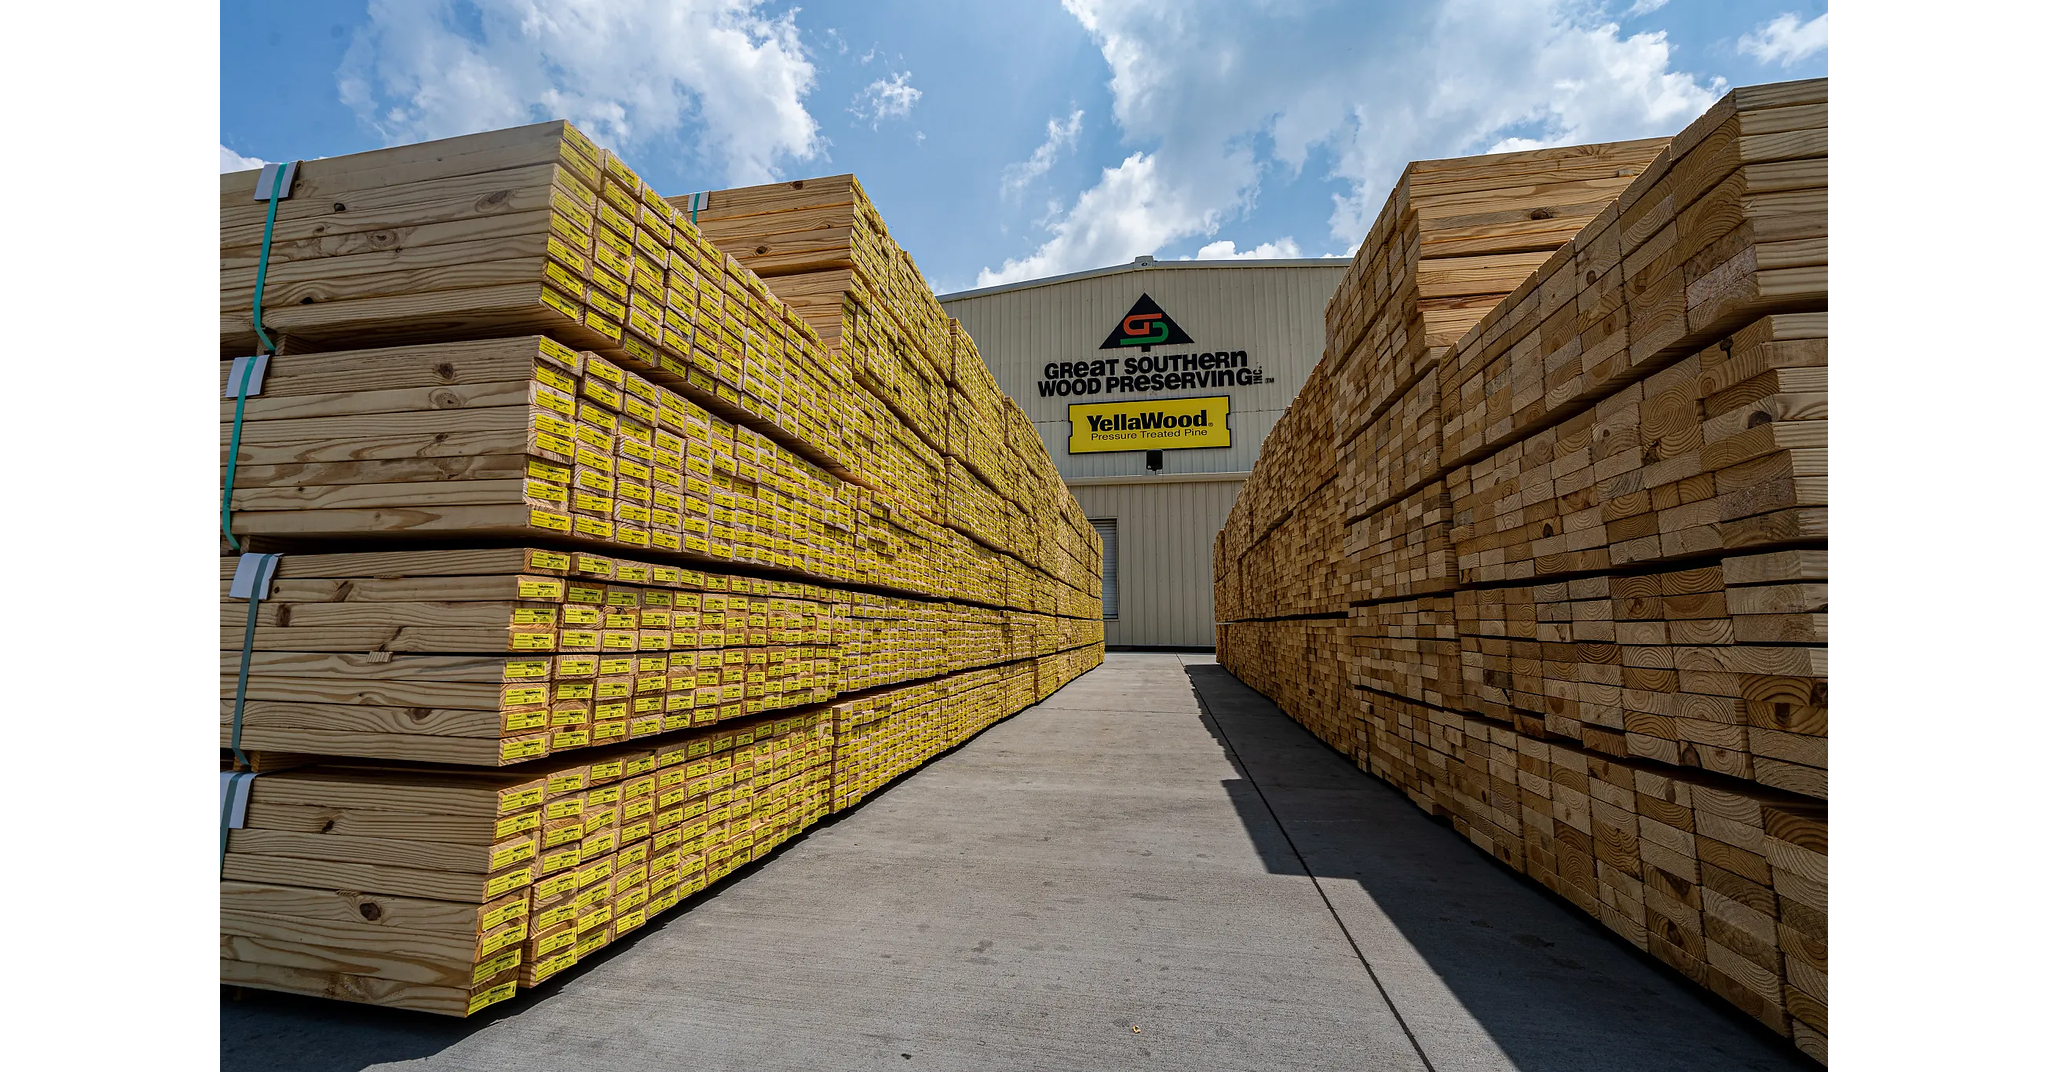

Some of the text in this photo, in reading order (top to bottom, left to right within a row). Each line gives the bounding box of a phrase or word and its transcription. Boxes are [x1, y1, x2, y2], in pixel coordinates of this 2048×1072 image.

[1038, 377, 1101, 397] WOOD
[1091, 427, 1208, 441] Pressure Treated Pine
